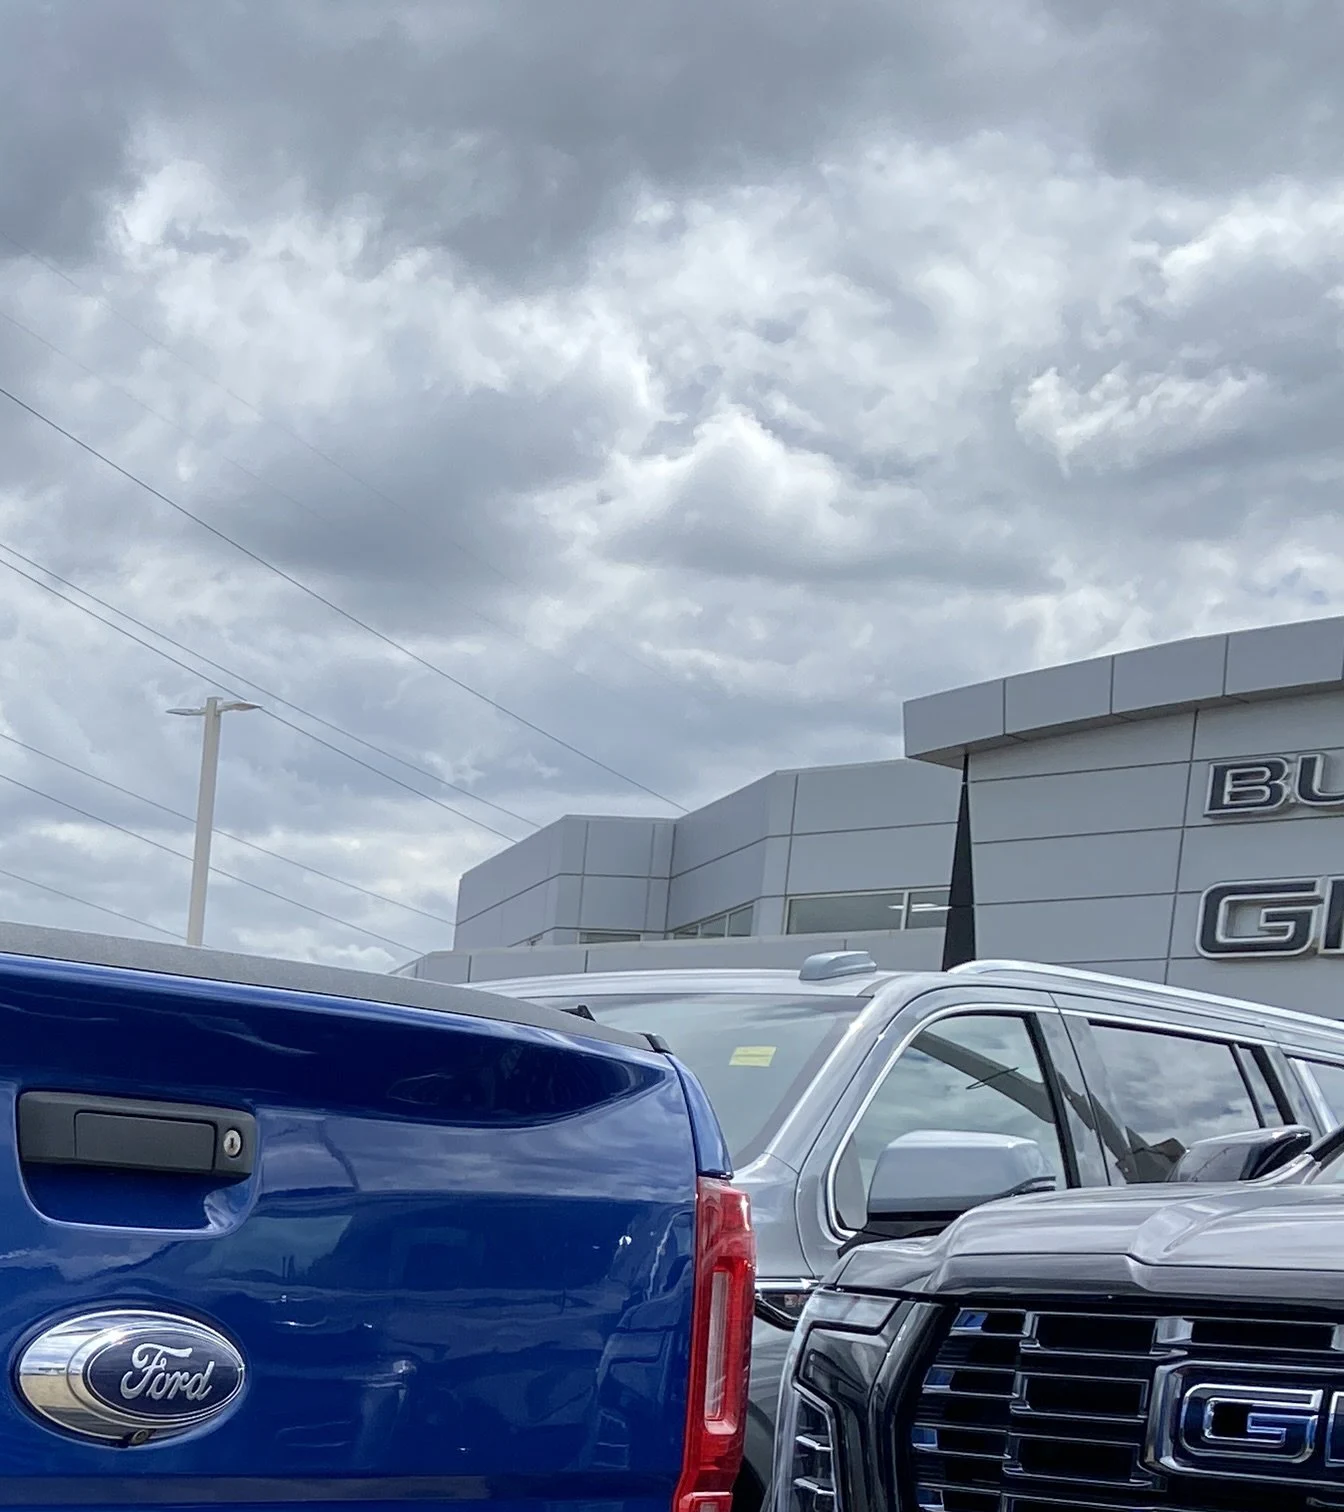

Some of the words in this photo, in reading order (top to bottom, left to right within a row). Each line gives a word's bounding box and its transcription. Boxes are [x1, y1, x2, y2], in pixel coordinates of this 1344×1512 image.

[1195, 875, 1344, 959] G
[120, 1342, 216, 1401] Ford
[1180, 1383, 1344, 1469] G
